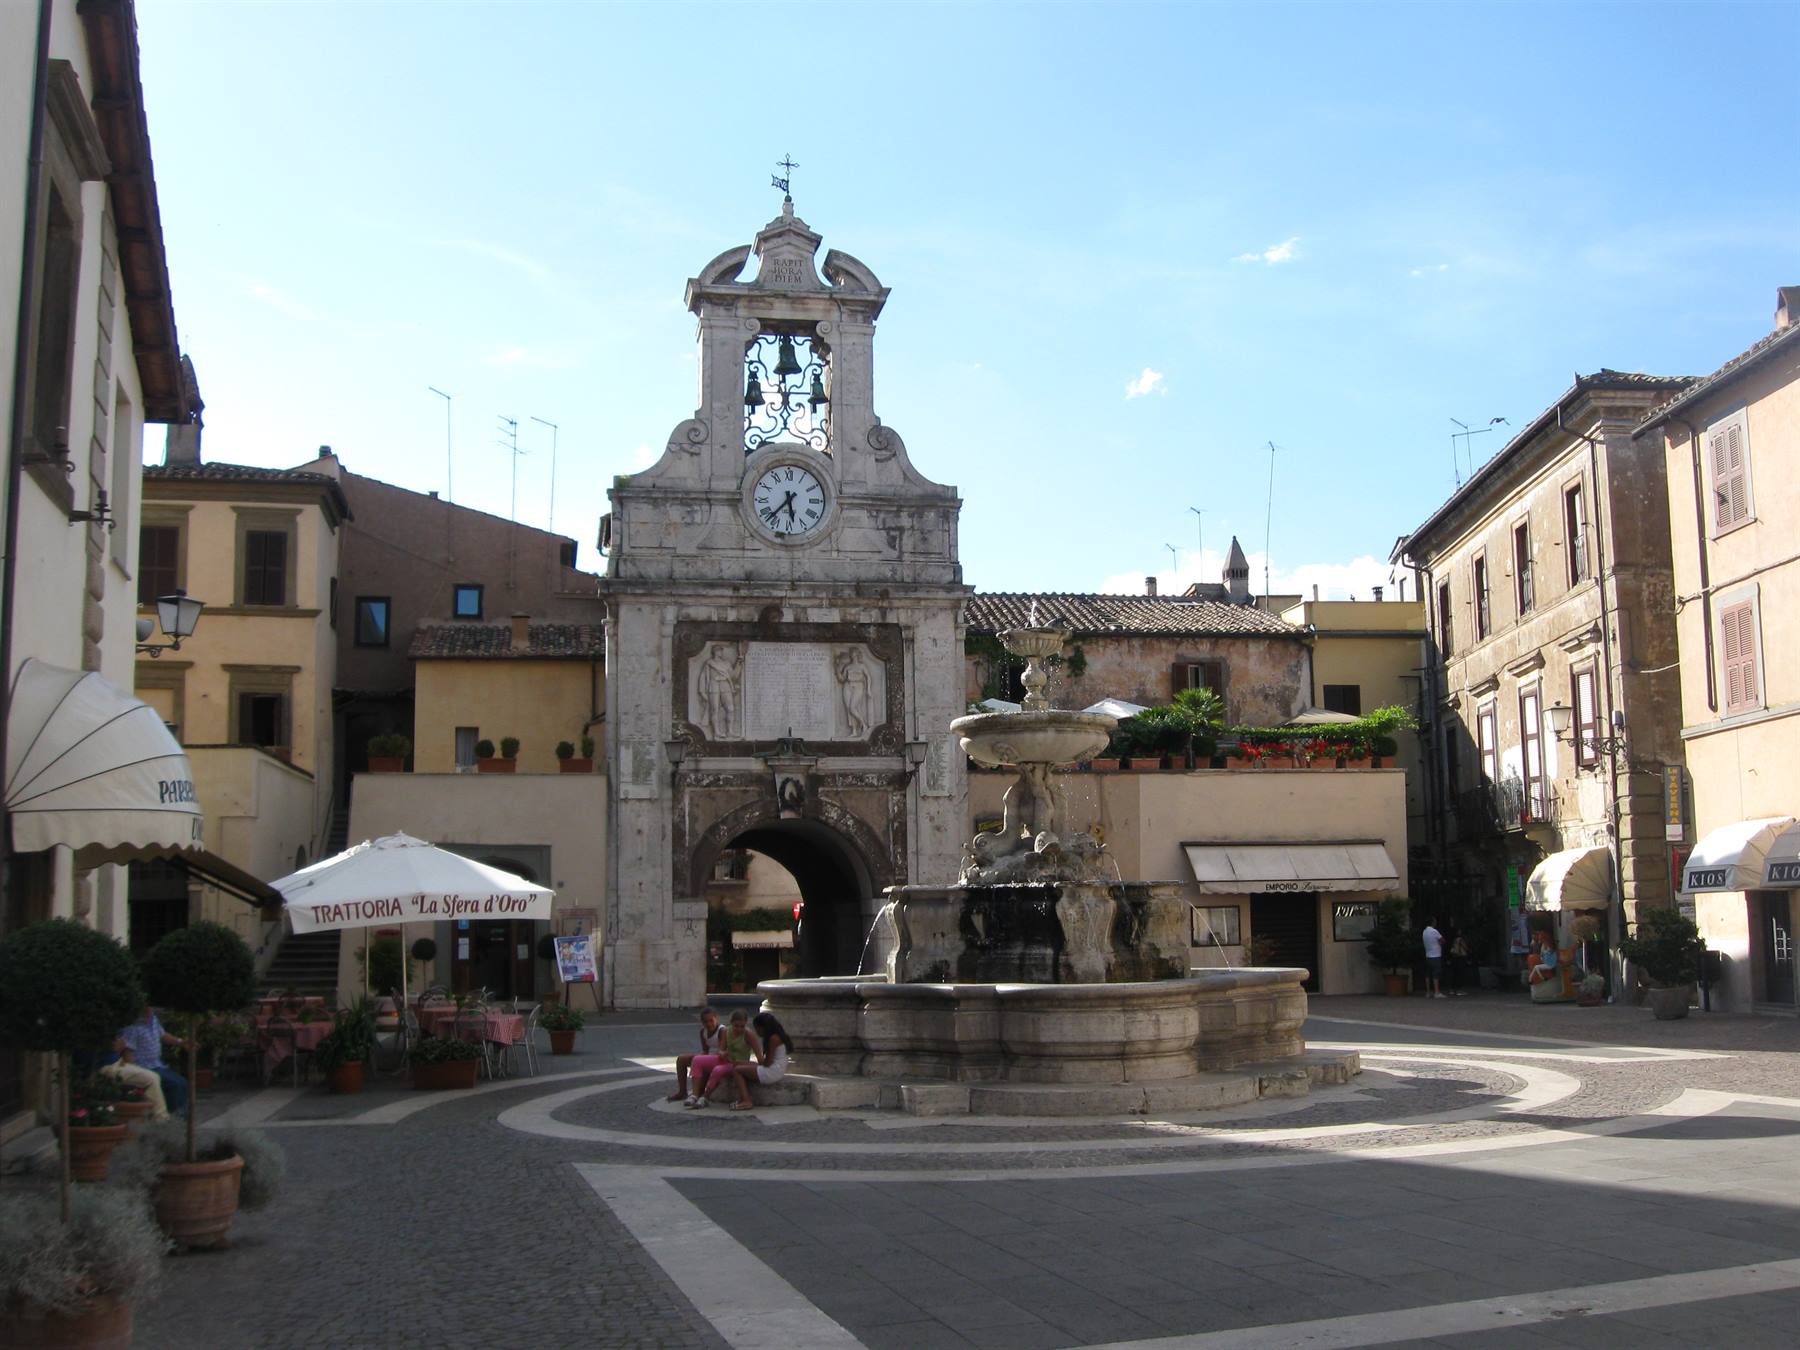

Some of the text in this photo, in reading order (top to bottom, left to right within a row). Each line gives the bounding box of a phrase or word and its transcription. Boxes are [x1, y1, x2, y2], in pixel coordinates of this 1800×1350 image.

[774, 259, 802, 267] RAPIT
[773, 267, 802, 275] HORA
[774, 275, 802, 283] DIEM
[784, 470, 794, 481] XII
[761, 483, 772, 492] X
[1669, 775, 1680, 825] TAVERNA
[1690, 872, 1724, 887] KIOS
[1265, 882, 1298, 891] EMPORIO
[311, 898, 403, 924] TRATTORIA
[441, 895, 480, 918] Sfera
